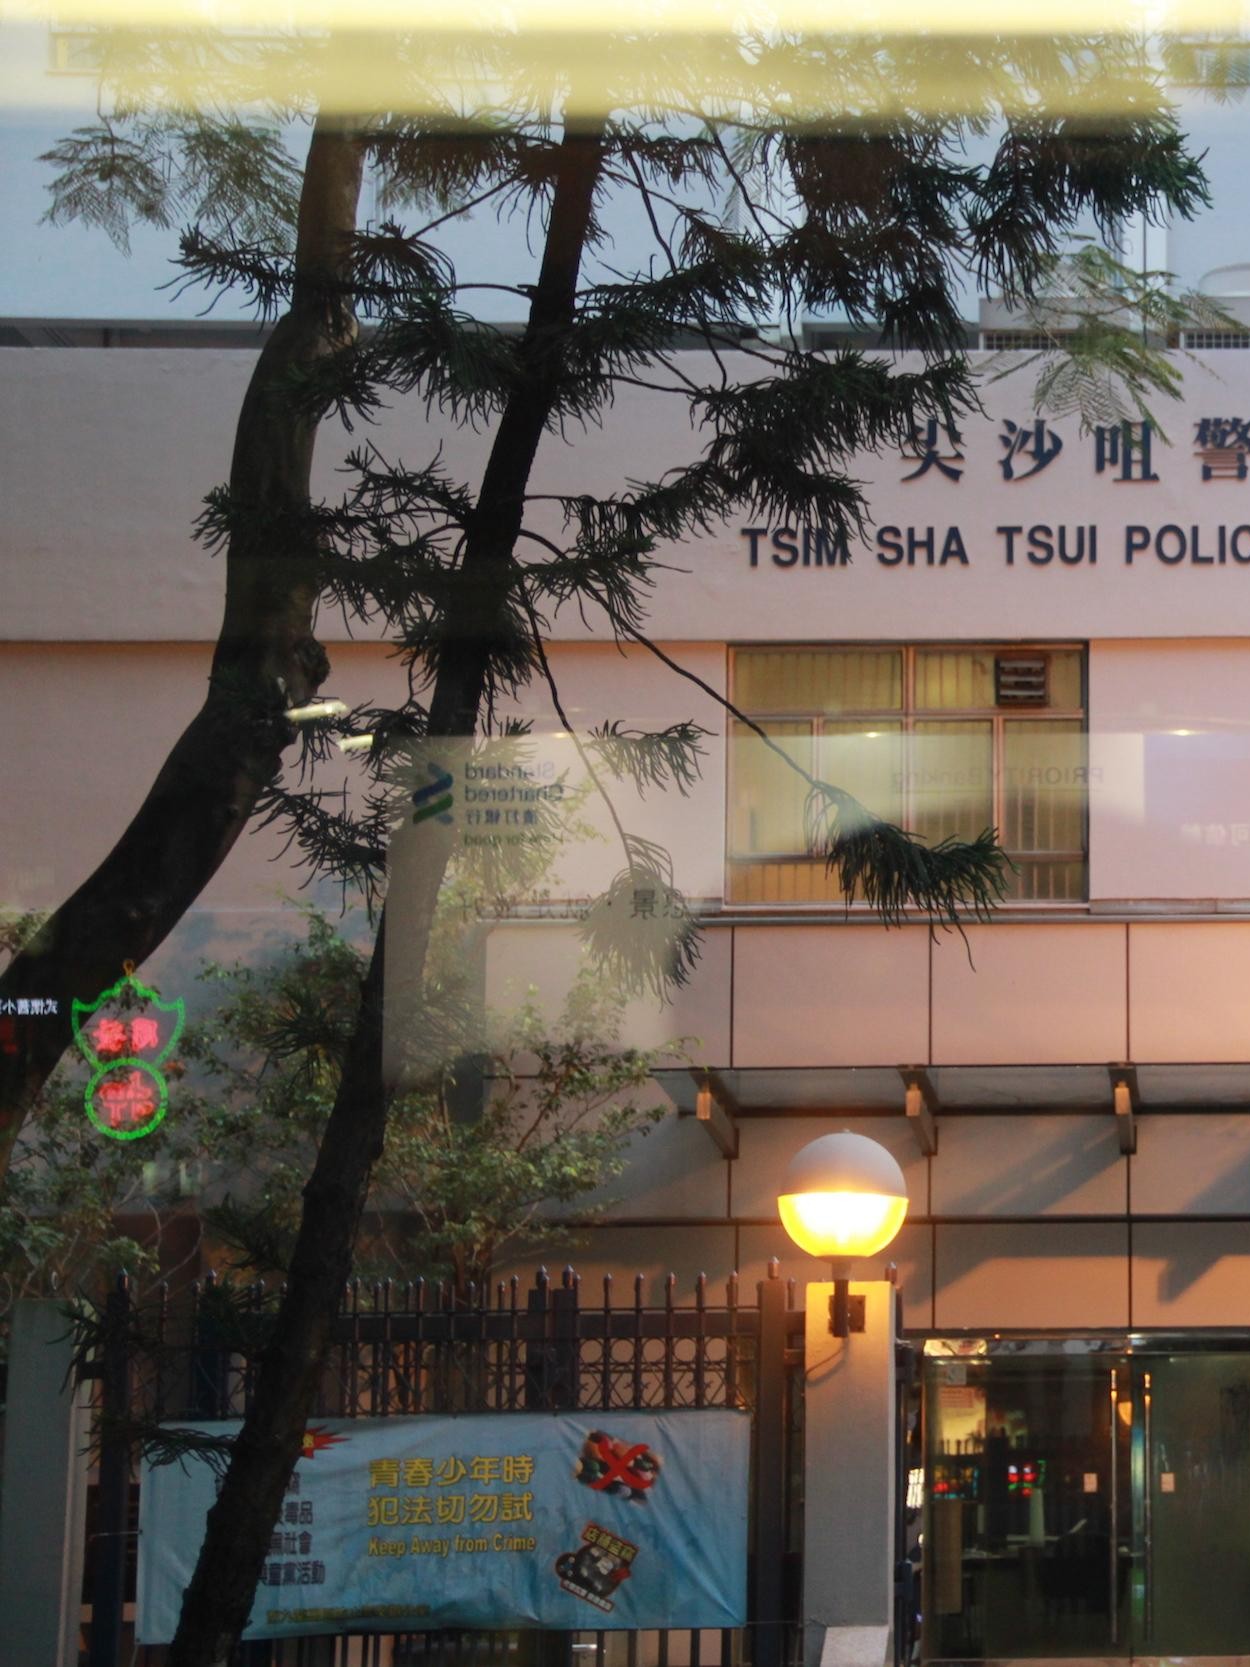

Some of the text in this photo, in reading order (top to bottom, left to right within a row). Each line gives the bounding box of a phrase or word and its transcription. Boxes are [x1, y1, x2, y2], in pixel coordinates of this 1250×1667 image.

[740, 525, 849, 568] TSIM
[876, 525, 970, 566] SHA
[997, 525, 1099, 565] TSUI
[368, 1455, 535, 1489] 青春少年時
[279, 1500, 313, 1526] 毒品
[368, 1491, 534, 1527] 犯法切勿試
[368, 1532, 537, 1558] Keep Away from Crime
